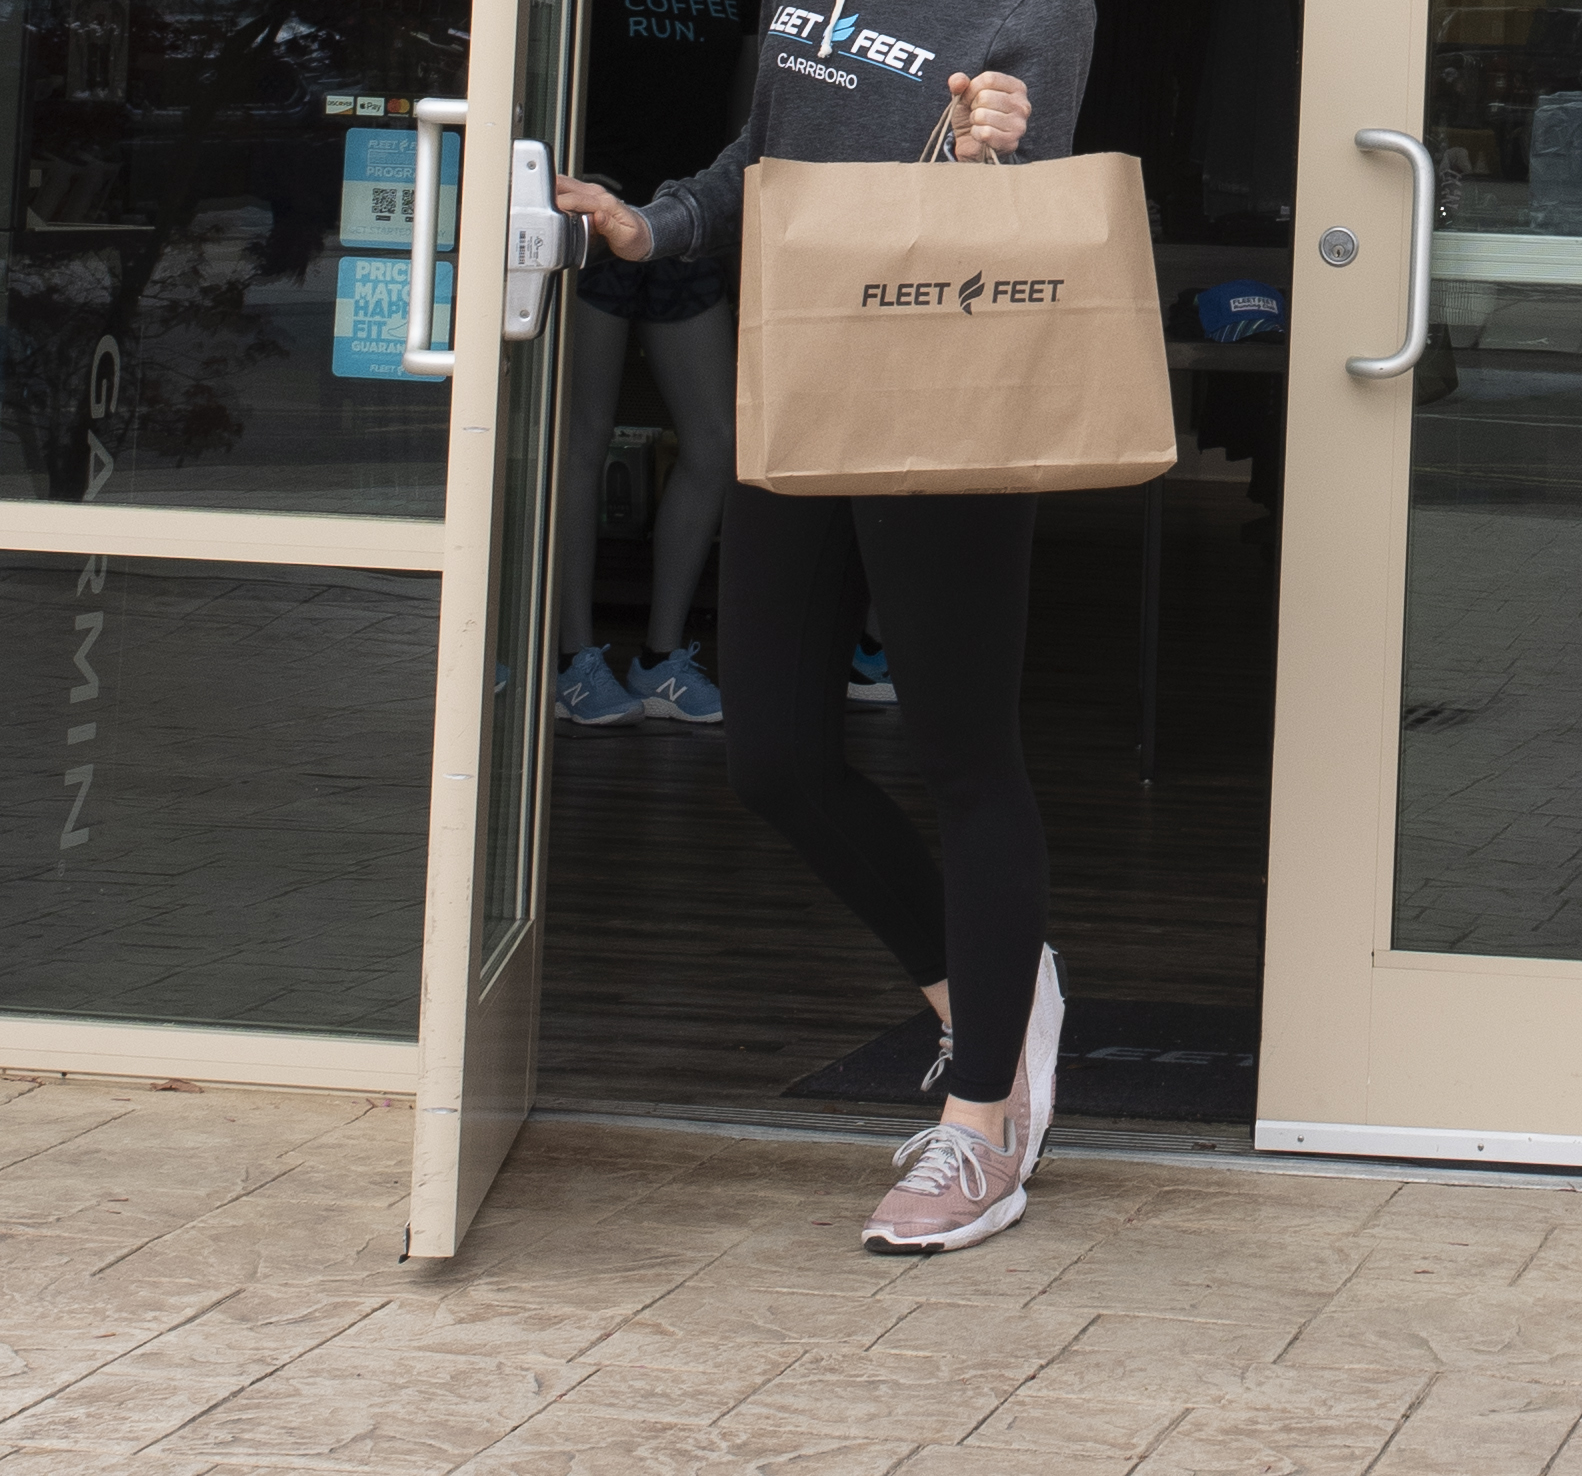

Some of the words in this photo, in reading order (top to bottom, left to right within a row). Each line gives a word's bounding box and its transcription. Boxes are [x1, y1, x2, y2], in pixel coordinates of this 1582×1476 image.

[776, 52, 858, 90] CARRBORO
[366, 102, 381, 113] Pay
[366, 166, 416, 178] PROGR
[355, 260, 411, 282] PRIC
[861, 281, 952, 307] FLEET
[353, 320, 387, 339] FIT
